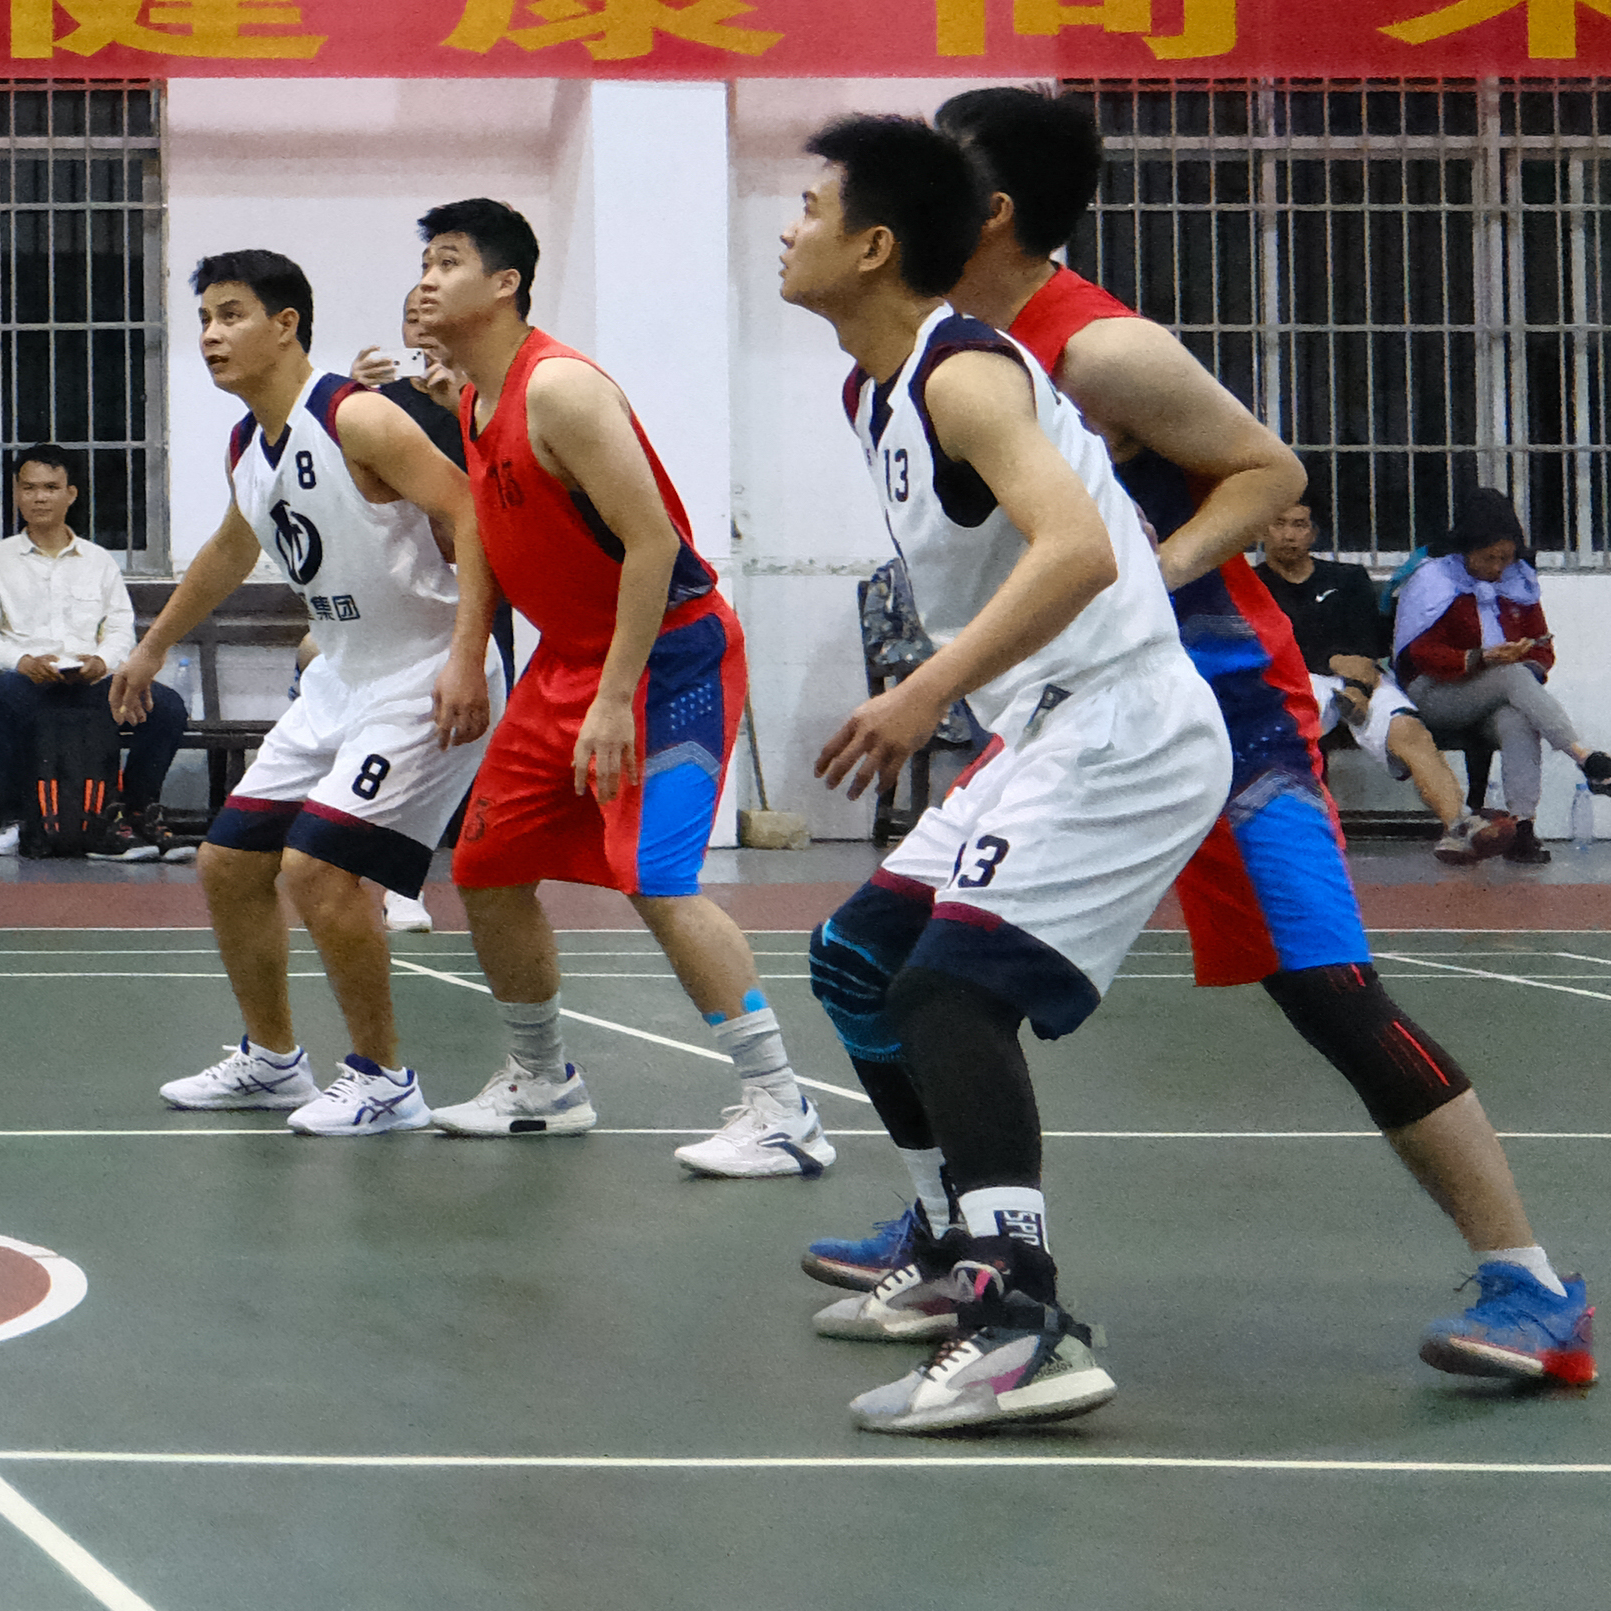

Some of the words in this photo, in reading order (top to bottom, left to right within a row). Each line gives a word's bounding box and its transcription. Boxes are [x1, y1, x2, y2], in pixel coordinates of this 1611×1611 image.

[295, 450, 318, 489] 8
[884, 448, 909, 503] 13
[298, 592, 361, 621] 集团
[351, 753, 391, 801] 8
